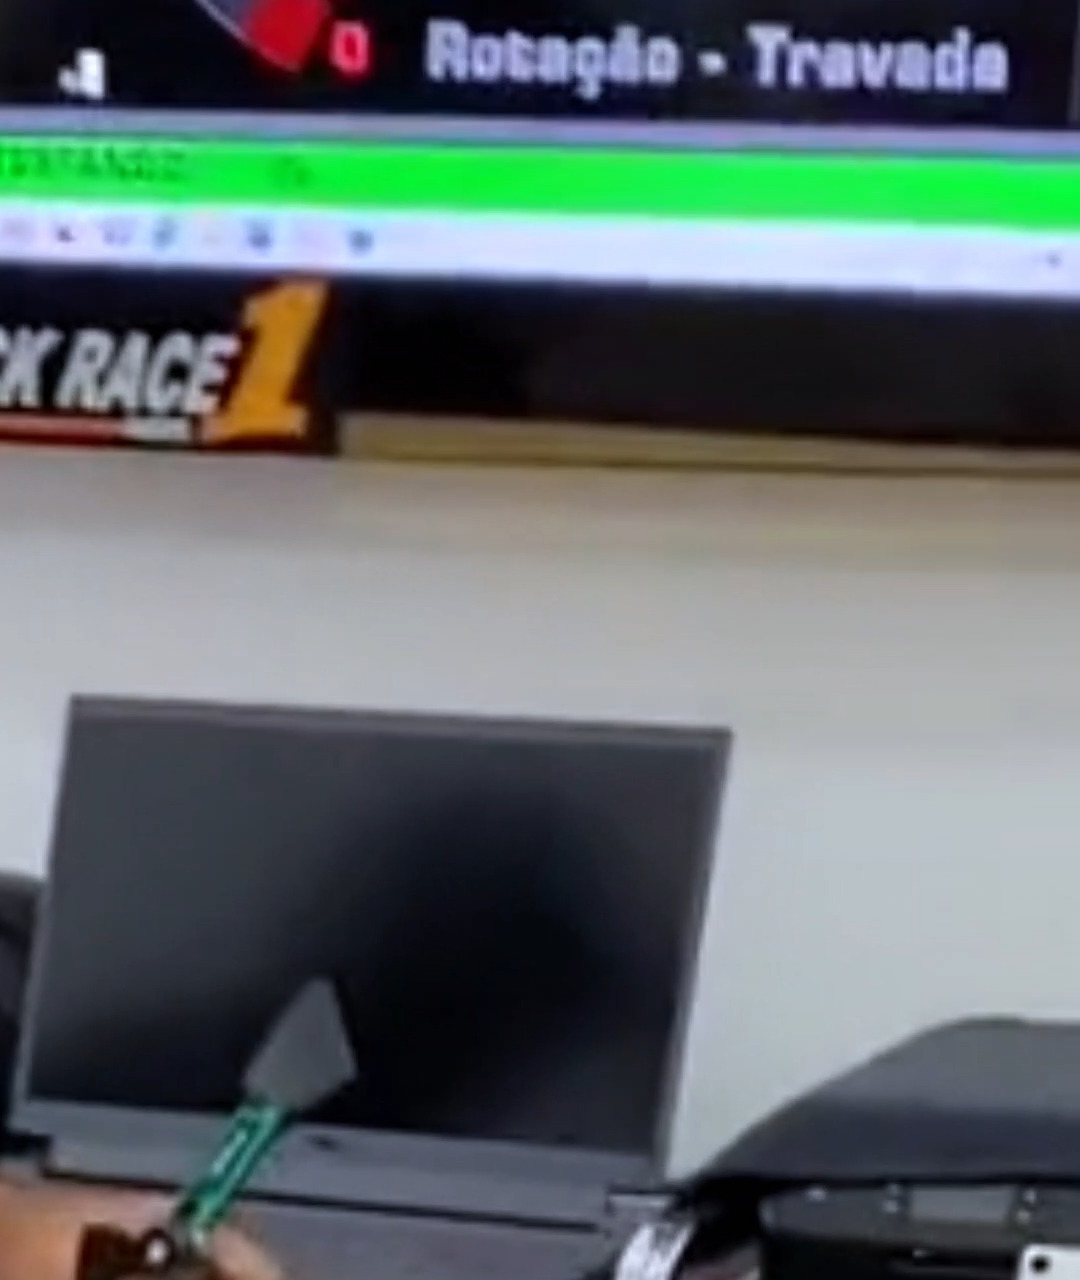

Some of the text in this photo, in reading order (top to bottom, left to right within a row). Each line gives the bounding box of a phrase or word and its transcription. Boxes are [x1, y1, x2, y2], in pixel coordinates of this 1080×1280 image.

[330, 22, 369, 76] 0
[426, 19, 681, 99] Rotação
[746, 24, 1009, 92] Travada
